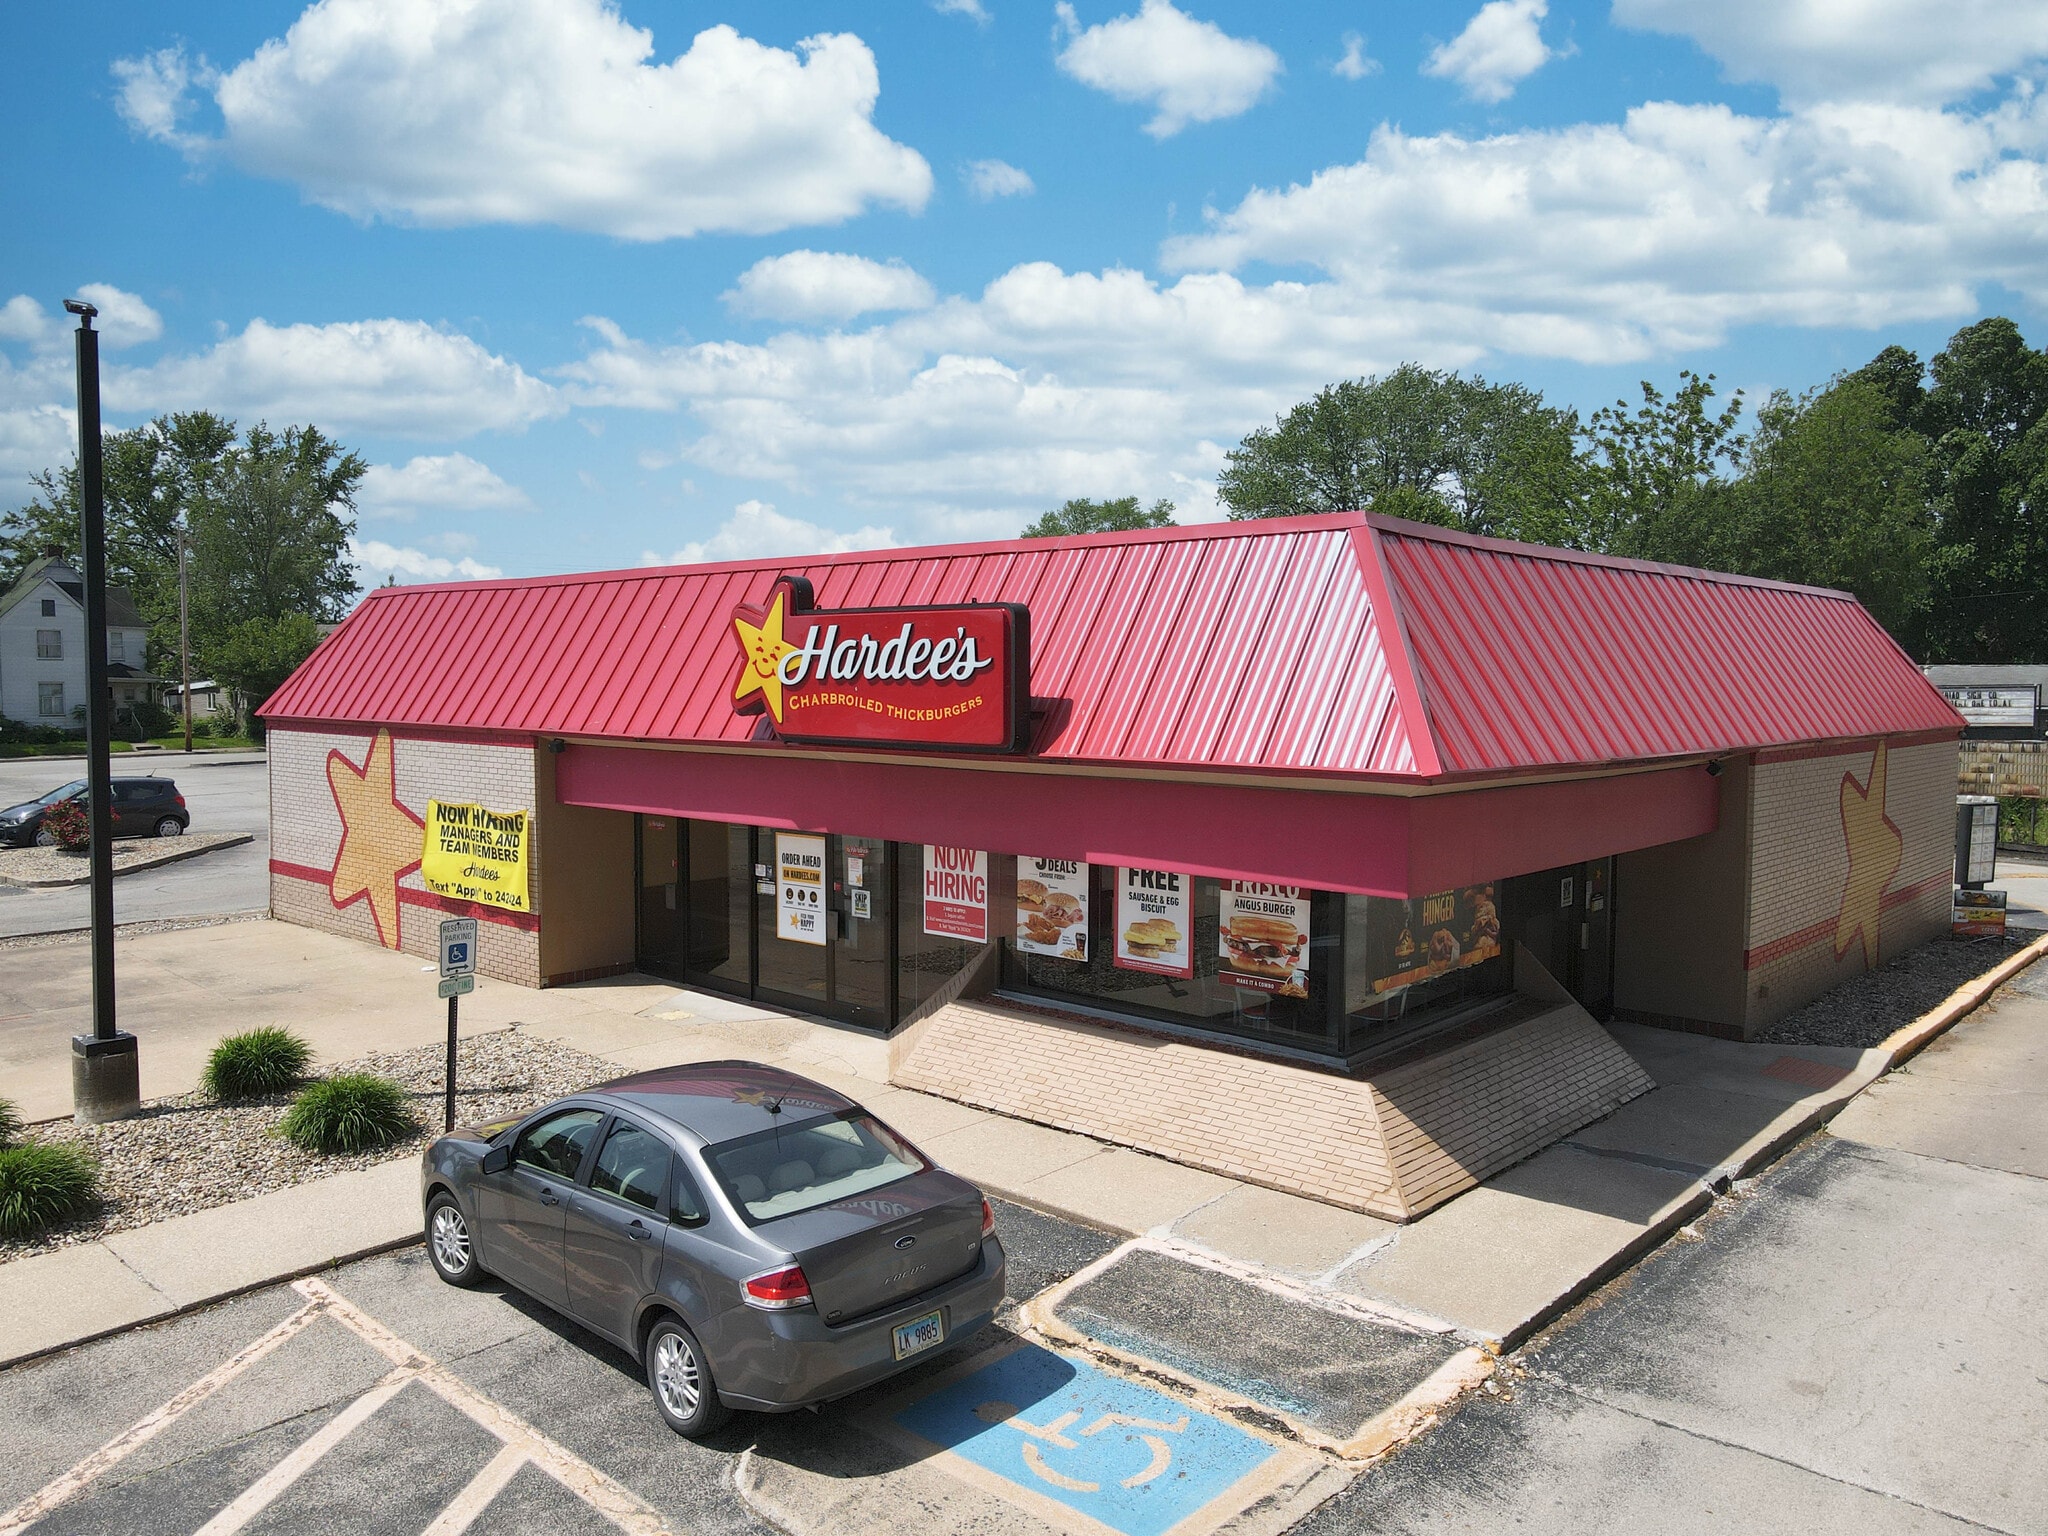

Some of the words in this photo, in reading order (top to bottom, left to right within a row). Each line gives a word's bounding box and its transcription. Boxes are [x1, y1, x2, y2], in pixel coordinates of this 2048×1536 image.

[777, 623, 993, 686] Hardee's
[789, 693, 884, 714] CHARBROILED
[887, 696, 984, 721] THICKBURGERS
[436, 804, 469, 825] NOW
[472, 808, 524, 833] HIRING
[440, 825, 493, 845] MANAGERS
[495, 834, 520, 848] AND
[440, 839, 470, 855] TEAM
[472, 844, 519, 863] MEMBERS
[781, 852, 801, 866] ORDER
[802, 854, 821, 868] AHEAD
[934, 845, 977, 872] NOW
[1048, 859, 1077, 874] DEALS
[429, 879, 449, 893] Text
[483, 890, 493, 901] to
[926, 870, 985, 904] HIRING
[1128, 868, 1180, 892] FREE
[1128, 892, 1158, 904] SAUSAGE
[1160, 896, 1165, 905] &
[1166, 896, 1180, 906] EGG
[1141, 903, 1167, 914] BISCUIT
[1234, 899, 1261, 911] ANGUS
[1262, 902, 1296, 916] BURGER
[1423, 894, 1455, 927] HUNGER
[443, 922, 474, 933] RESERVED
[444, 933, 472, 942] PARKING
[885, 1263, 928, 1286] FOCUS
[898, 1332, 911, 1351] LK
[915, 1321, 938, 1344] 9885
